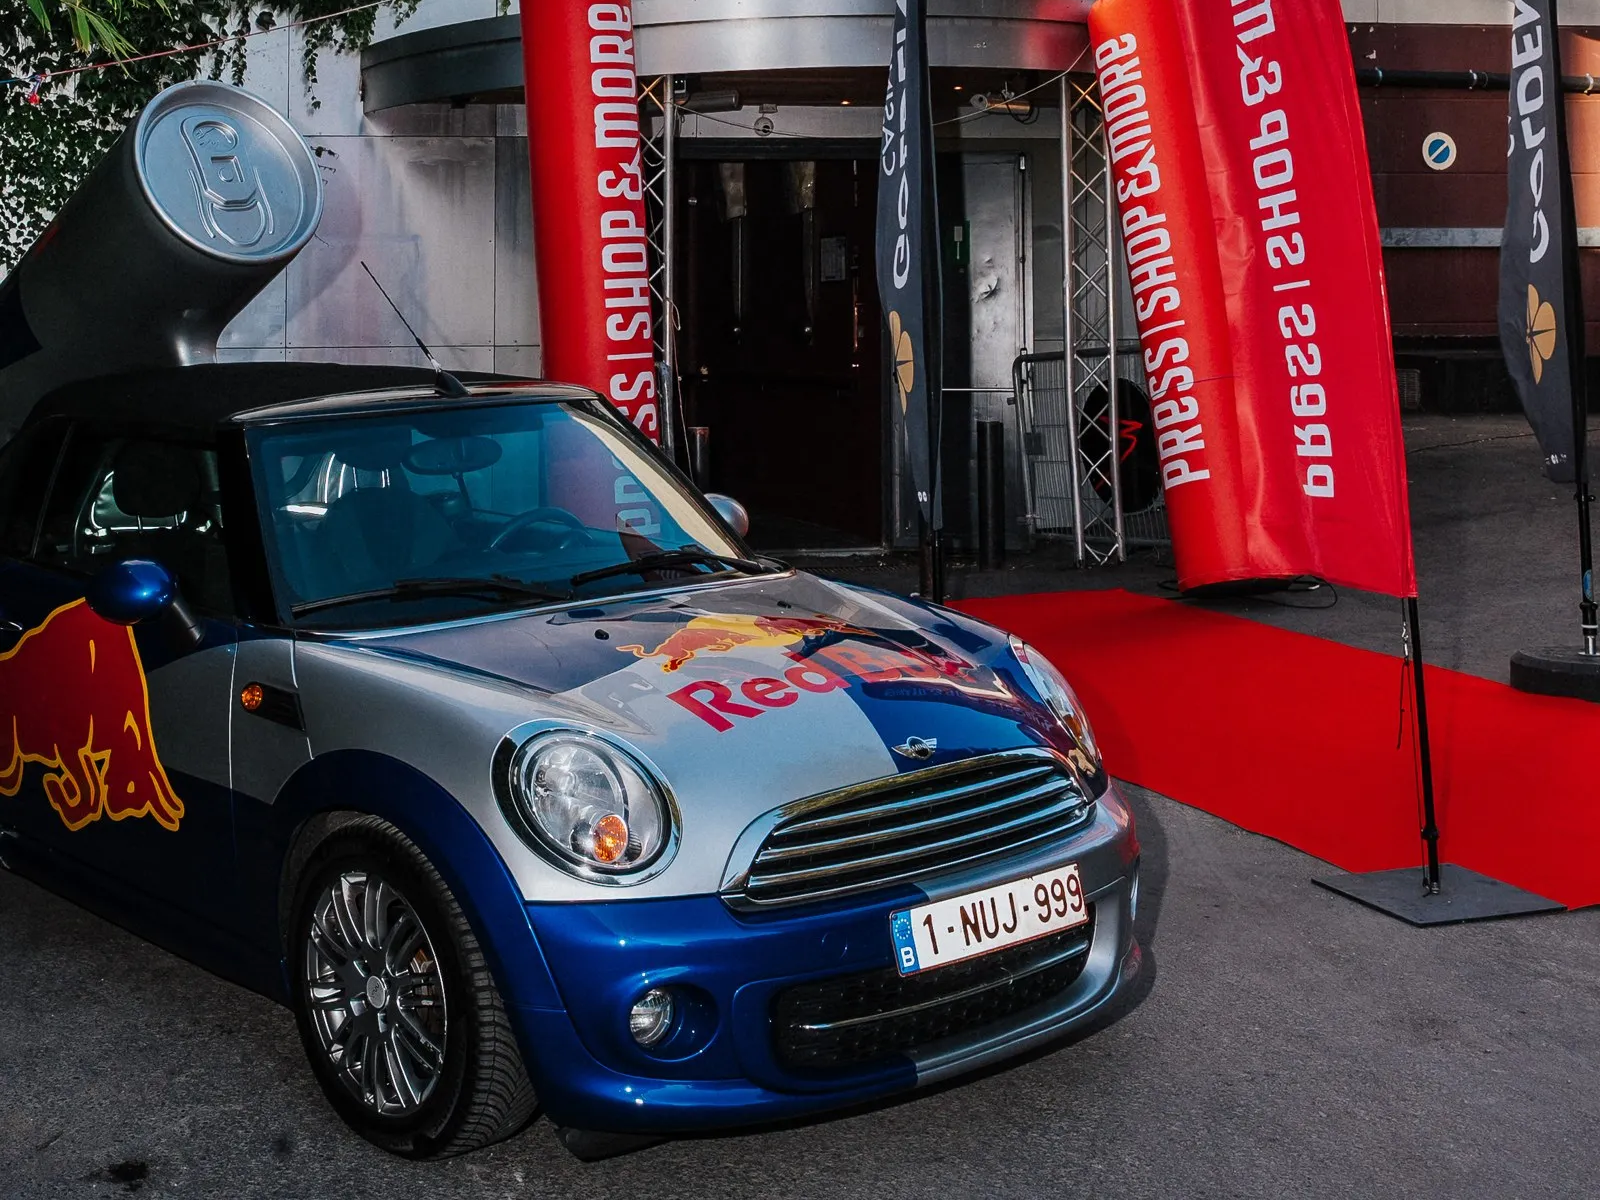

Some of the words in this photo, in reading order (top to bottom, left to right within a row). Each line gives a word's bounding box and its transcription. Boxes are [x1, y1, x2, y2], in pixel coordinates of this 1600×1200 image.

[601, 210, 651, 341] SHOP
[1123, 205, 1181, 322] SHOP
[667, 651, 850, 733] Red
[923, 873, 1083, 955] 1-NUJ-999
[900, 946, 915, 968] B
